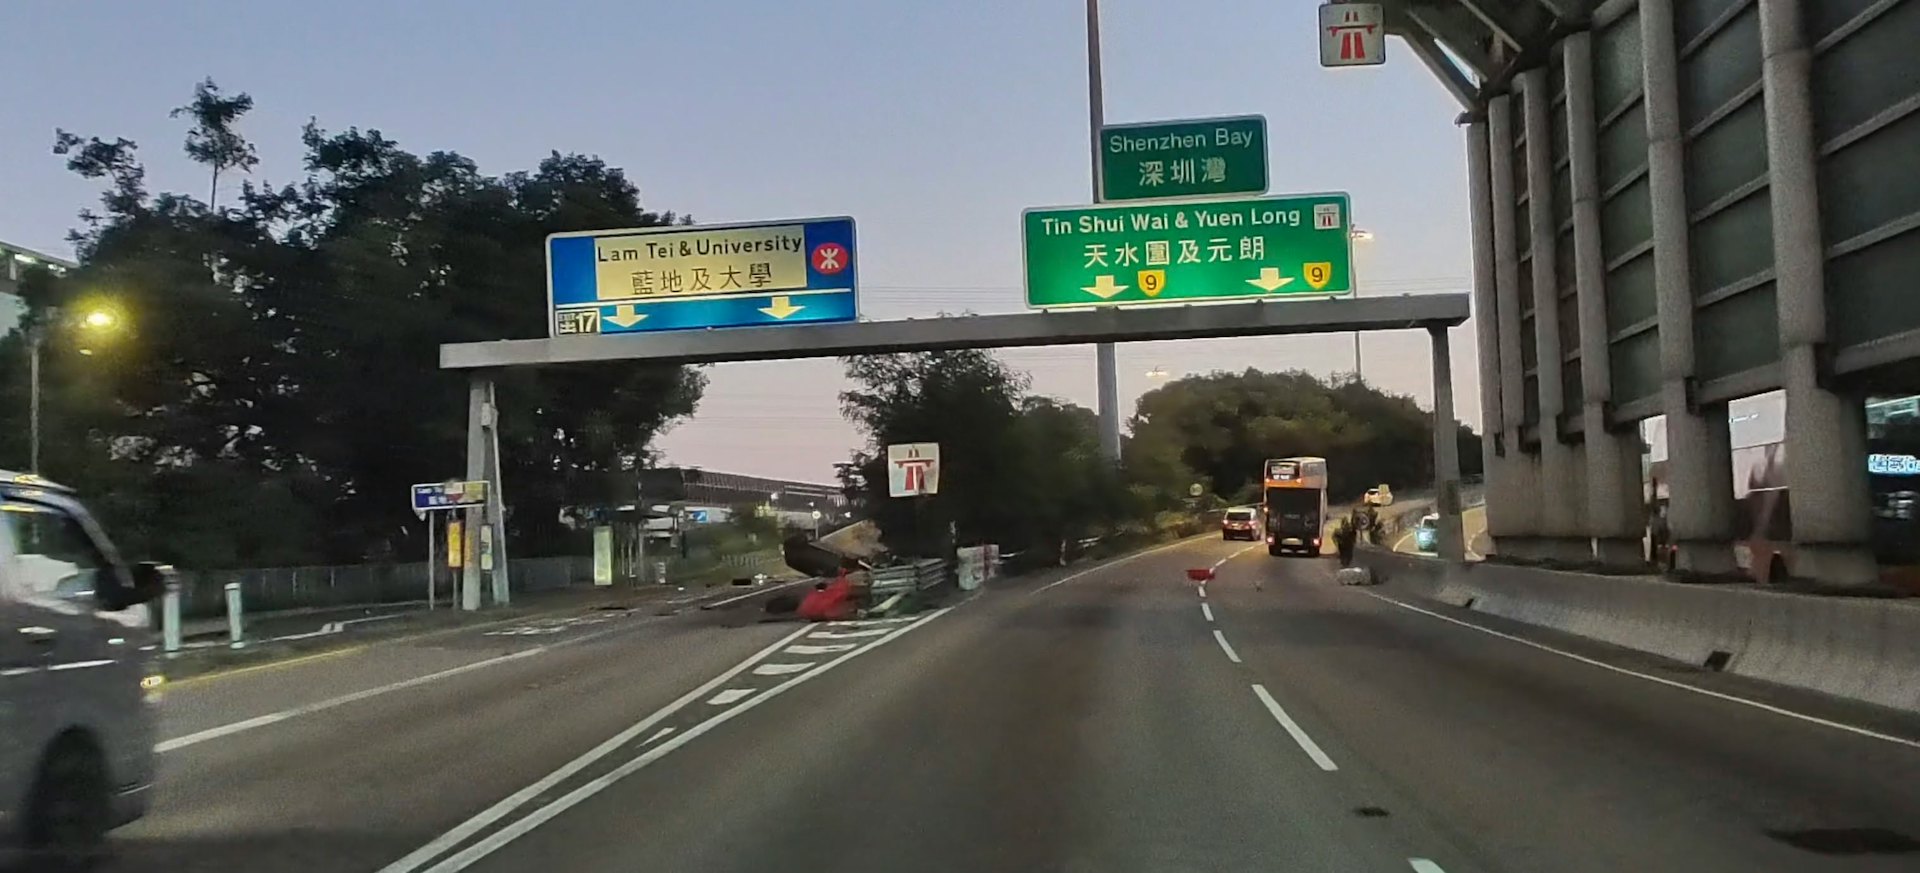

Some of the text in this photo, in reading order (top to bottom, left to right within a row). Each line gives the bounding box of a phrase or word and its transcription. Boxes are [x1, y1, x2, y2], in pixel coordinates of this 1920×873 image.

[1110, 127, 1253, 153] Shenzhen Bay
[1138, 156, 1227, 187] 深圳灣
[1041, 208, 1301, 236] Tin Shui Wai & Yuen Long
[597, 235, 803, 264] Lam Tei & University
[1083, 235, 1265, 269] 天水圍及元朗
[631, 262, 772, 295] 藍地及大學
[1145, 275, 1157, 291] 9
[1311, 267, 1323, 283] 9
[575, 312, 597, 333] 17
